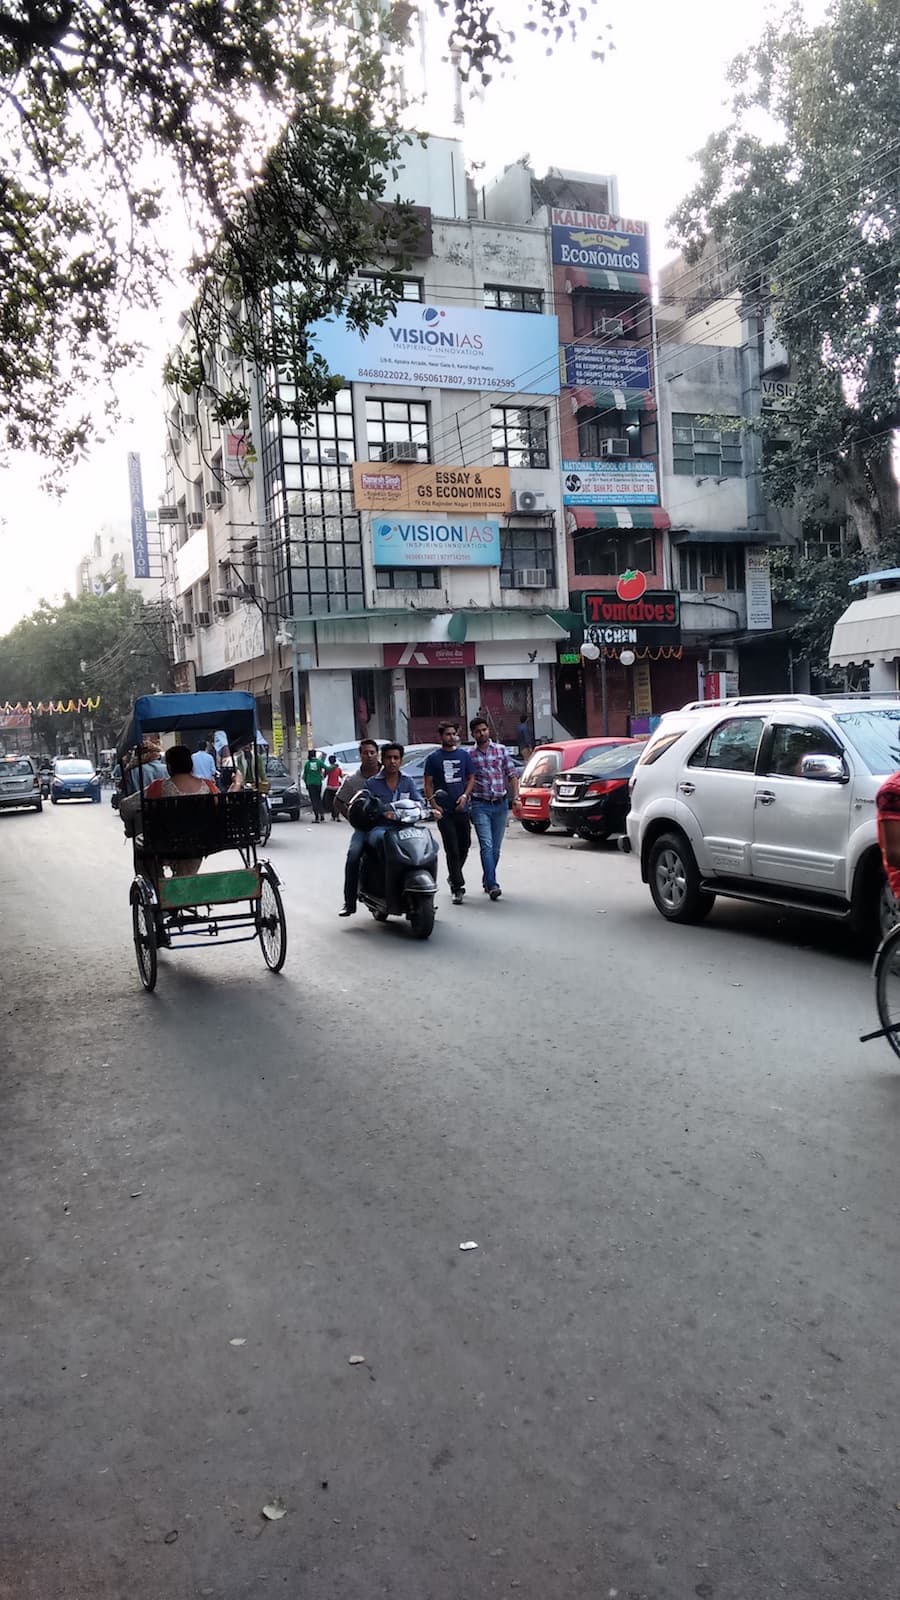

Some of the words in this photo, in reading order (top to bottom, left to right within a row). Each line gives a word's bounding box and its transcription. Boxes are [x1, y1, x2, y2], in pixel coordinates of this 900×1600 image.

[553, 209, 617, 231] KALINGA
[621, 217, 643, 234] IAS
[388, 326, 483, 350] VISIONIAS
[393, 343, 433, 353] INSPIRING
[435, 345, 485, 357] INNOVATION
[358, 368, 412, 381] 8468022022,
[413, 372, 466, 385] 9650617807,
[563, 462, 593, 471] NATIONAL
[594, 462, 618, 471] SCHOOL
[435, 472, 470, 484] ESSAY
[474, 473, 482, 484] &
[417, 485, 433, 498] GS
[436, 485, 501, 499] ECONOMICS
[397, 524, 494, 543] VISIONIAS
[587, 596, 675, 622] Tomatoes
